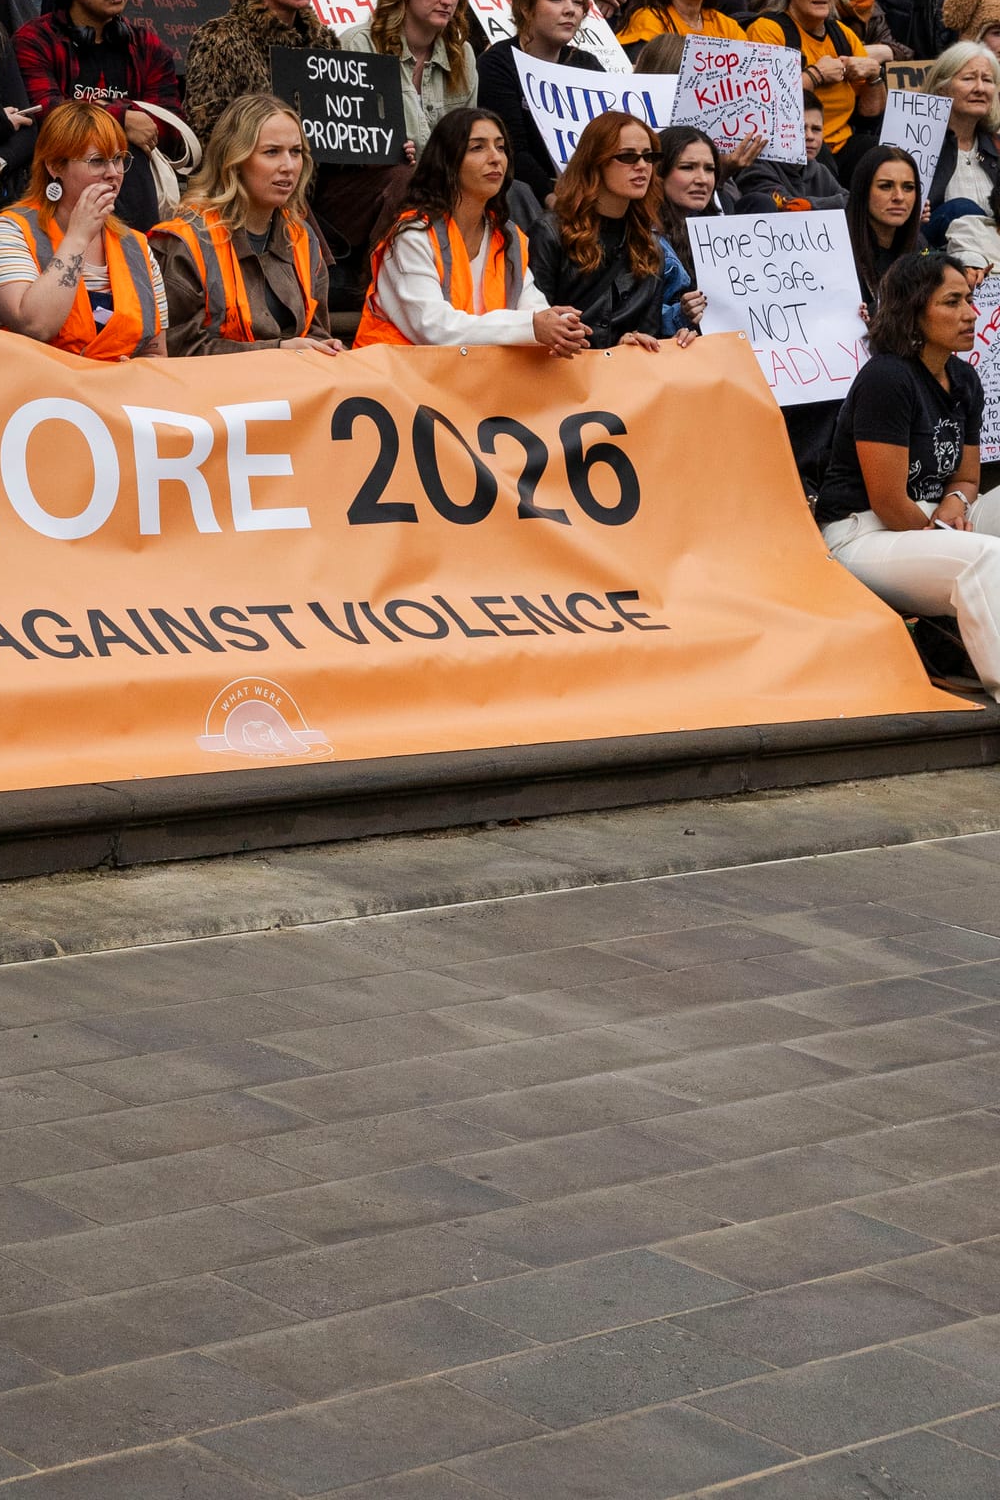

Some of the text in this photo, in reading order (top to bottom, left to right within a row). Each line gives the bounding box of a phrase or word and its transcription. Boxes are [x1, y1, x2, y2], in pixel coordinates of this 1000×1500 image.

[307, 56, 375, 90] SPOUSE,
[693, 51, 740, 75] Stop
[326, 94, 364, 120] NOT
[302, 119, 393, 156] PROPERTY
[905, 123, 931, 147] NO
[753, 219, 835, 258] Should
[728, 261, 824, 296] Be Safe.
[748, 302, 809, 344] NOT
[330, 396, 641, 526] 2026
[306, 590, 670, 645] VIOLENCE
[221, 685, 282, 712] WHAT WERE
